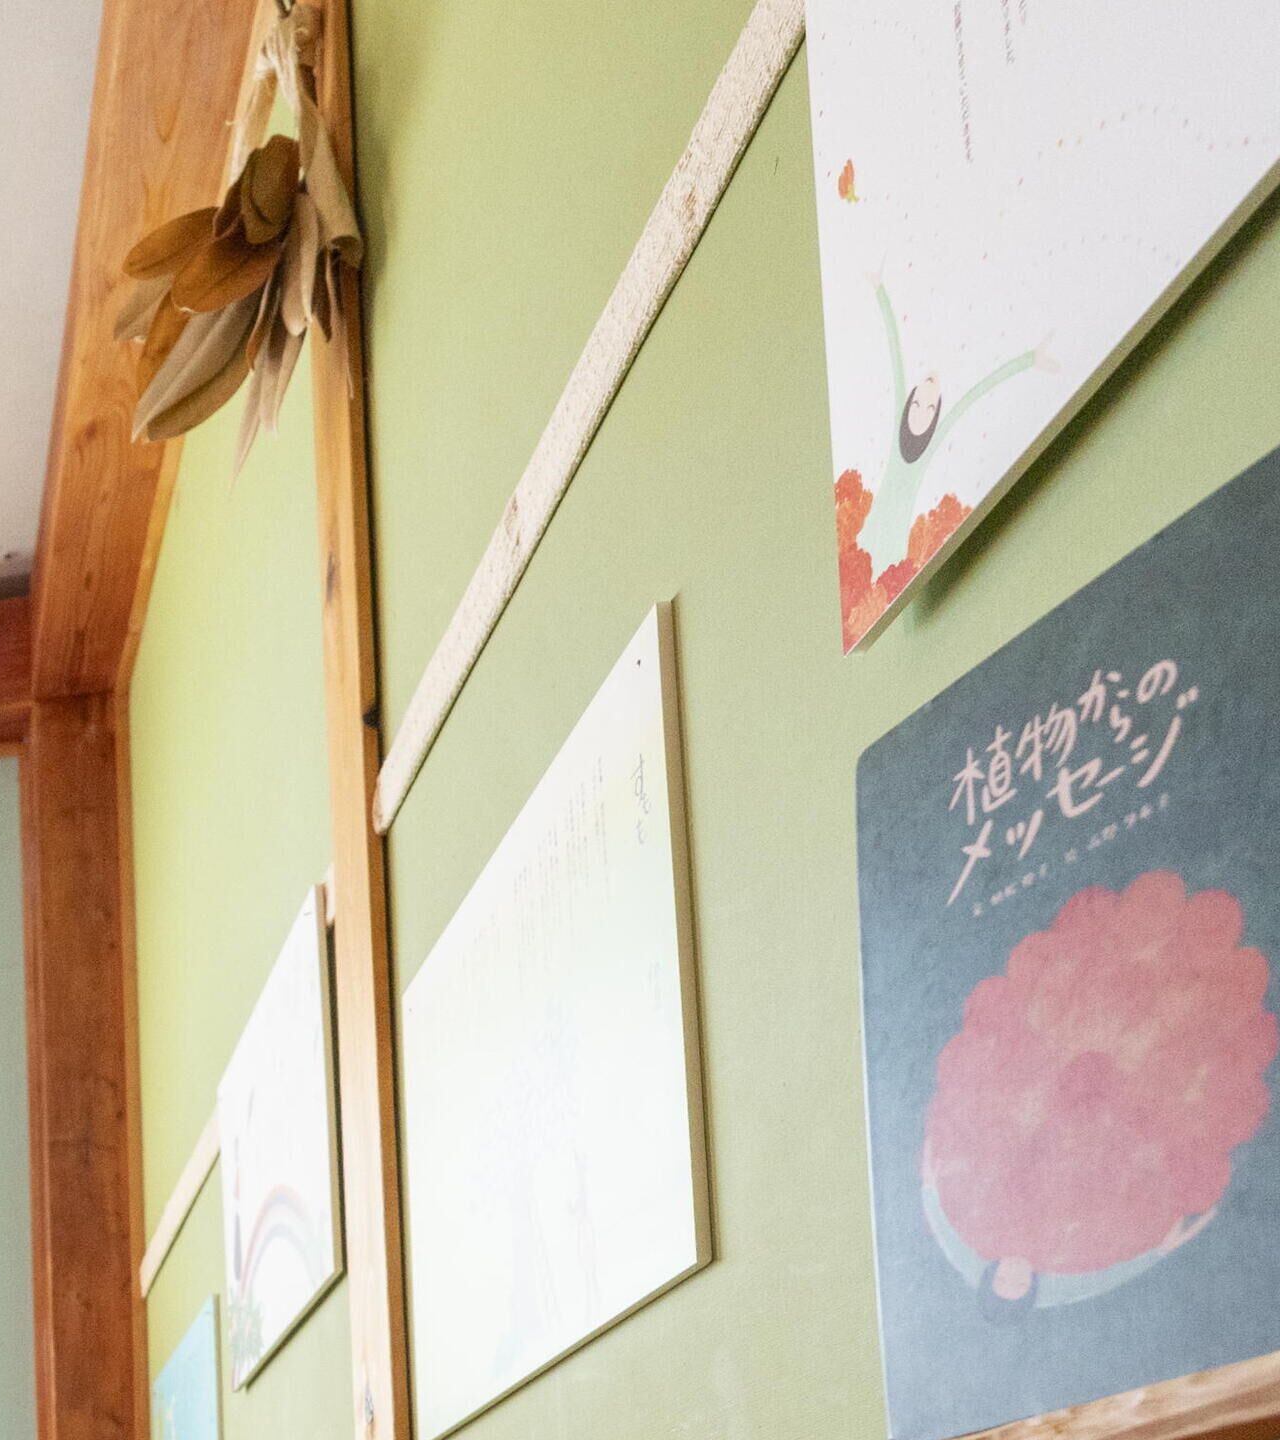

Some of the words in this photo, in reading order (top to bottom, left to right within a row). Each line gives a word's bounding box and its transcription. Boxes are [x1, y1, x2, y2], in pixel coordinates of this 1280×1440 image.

[946, 685, 1200, 907] メッセージ
[948, 659, 1178, 826] 植物からの
